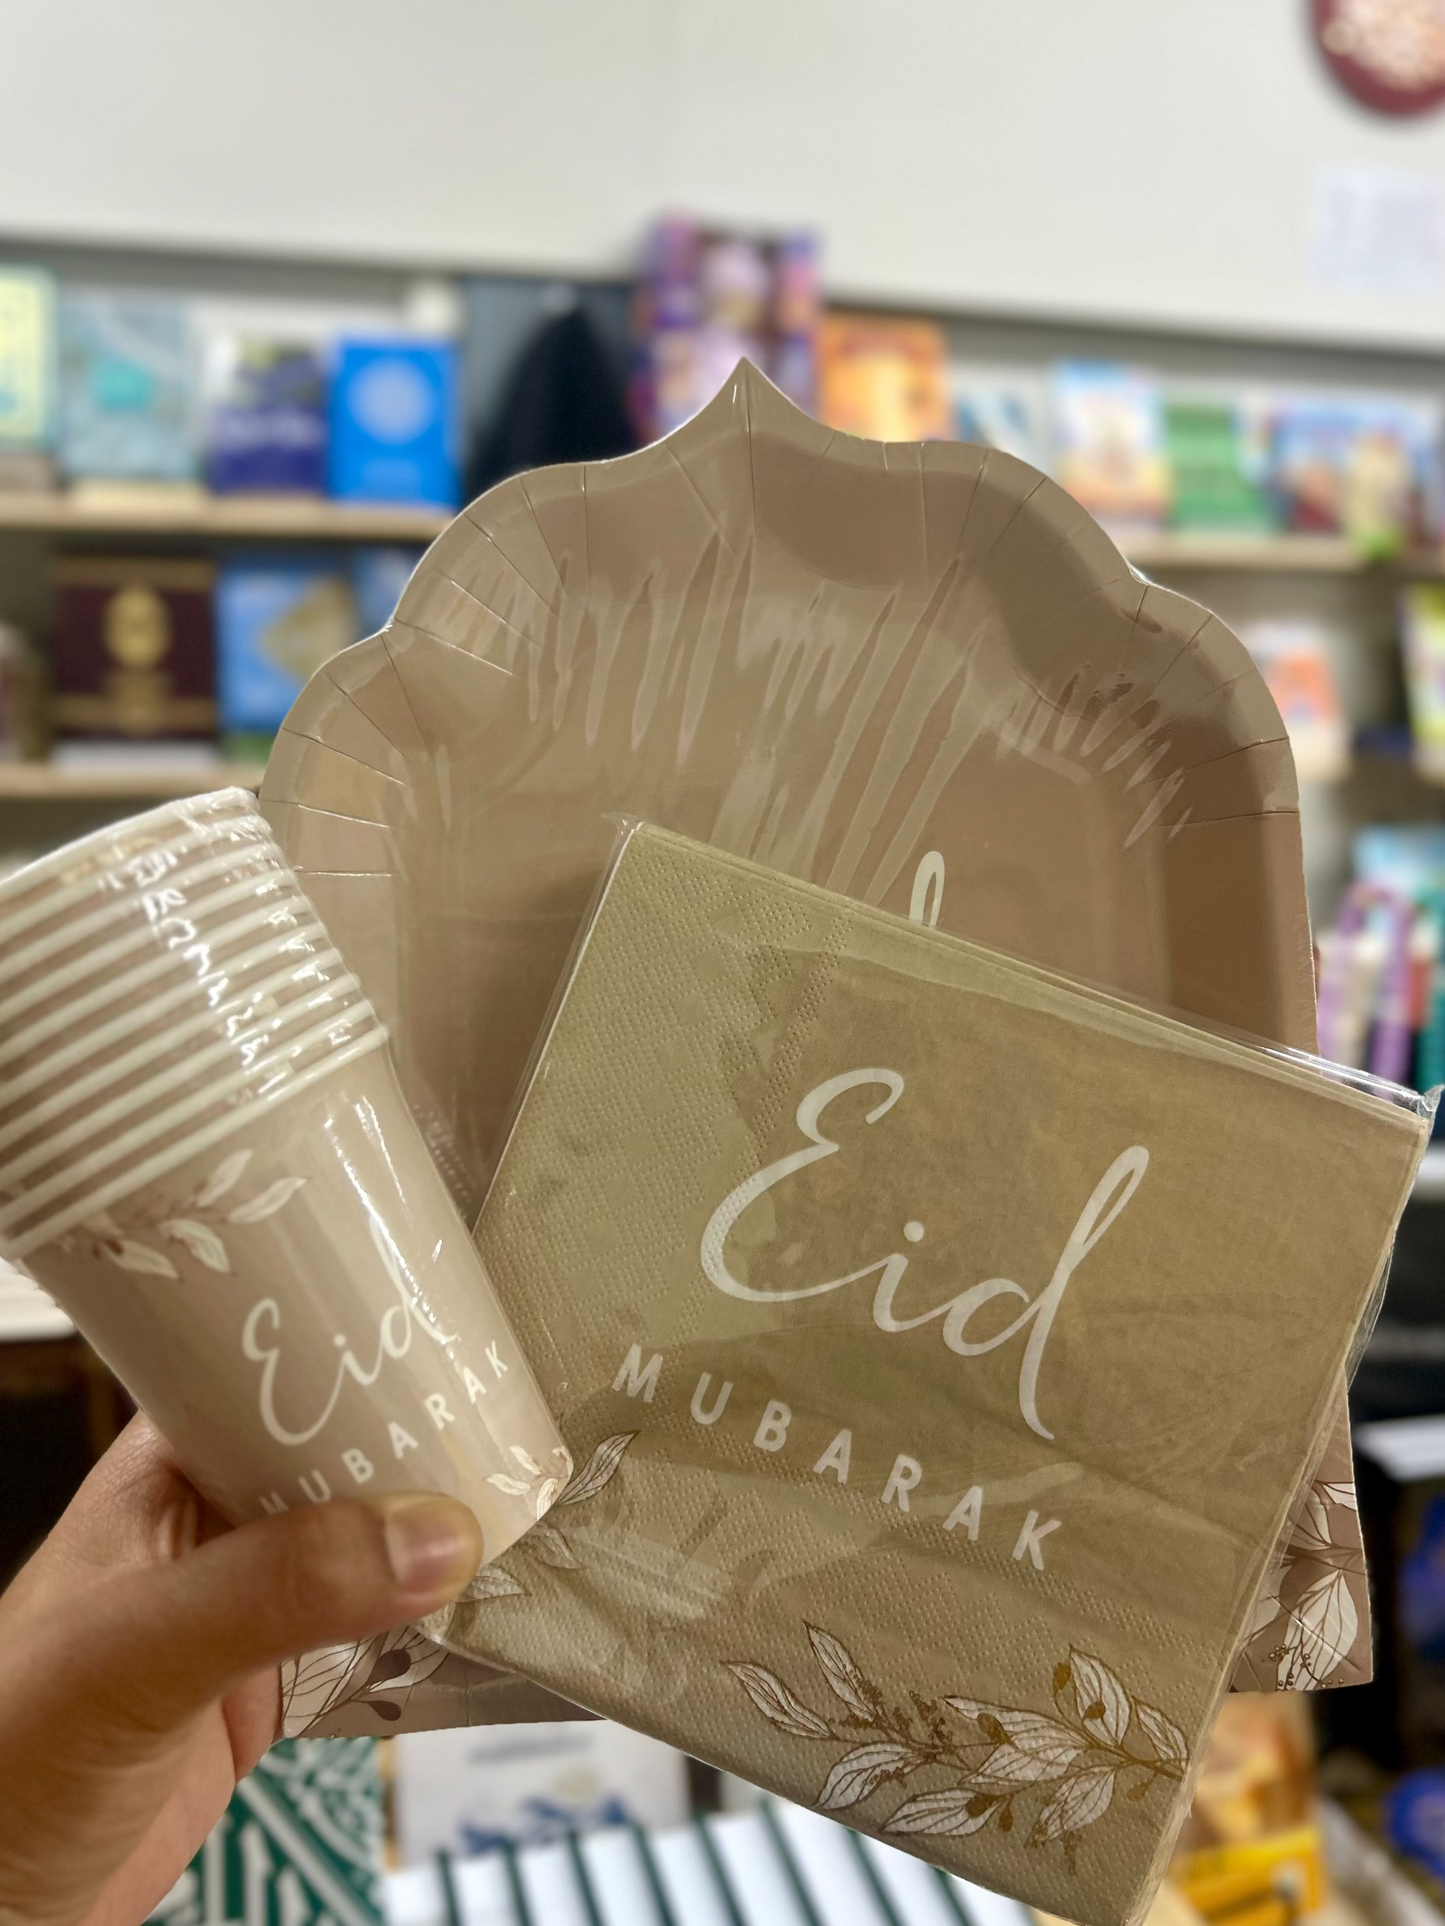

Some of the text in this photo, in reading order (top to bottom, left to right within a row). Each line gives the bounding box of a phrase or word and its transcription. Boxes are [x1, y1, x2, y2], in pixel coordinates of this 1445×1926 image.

[242, 1213, 461, 1446] Eid
[701, 1067, 1149, 1439] Eid
[611, 1344, 1062, 1570] MUBARAK
